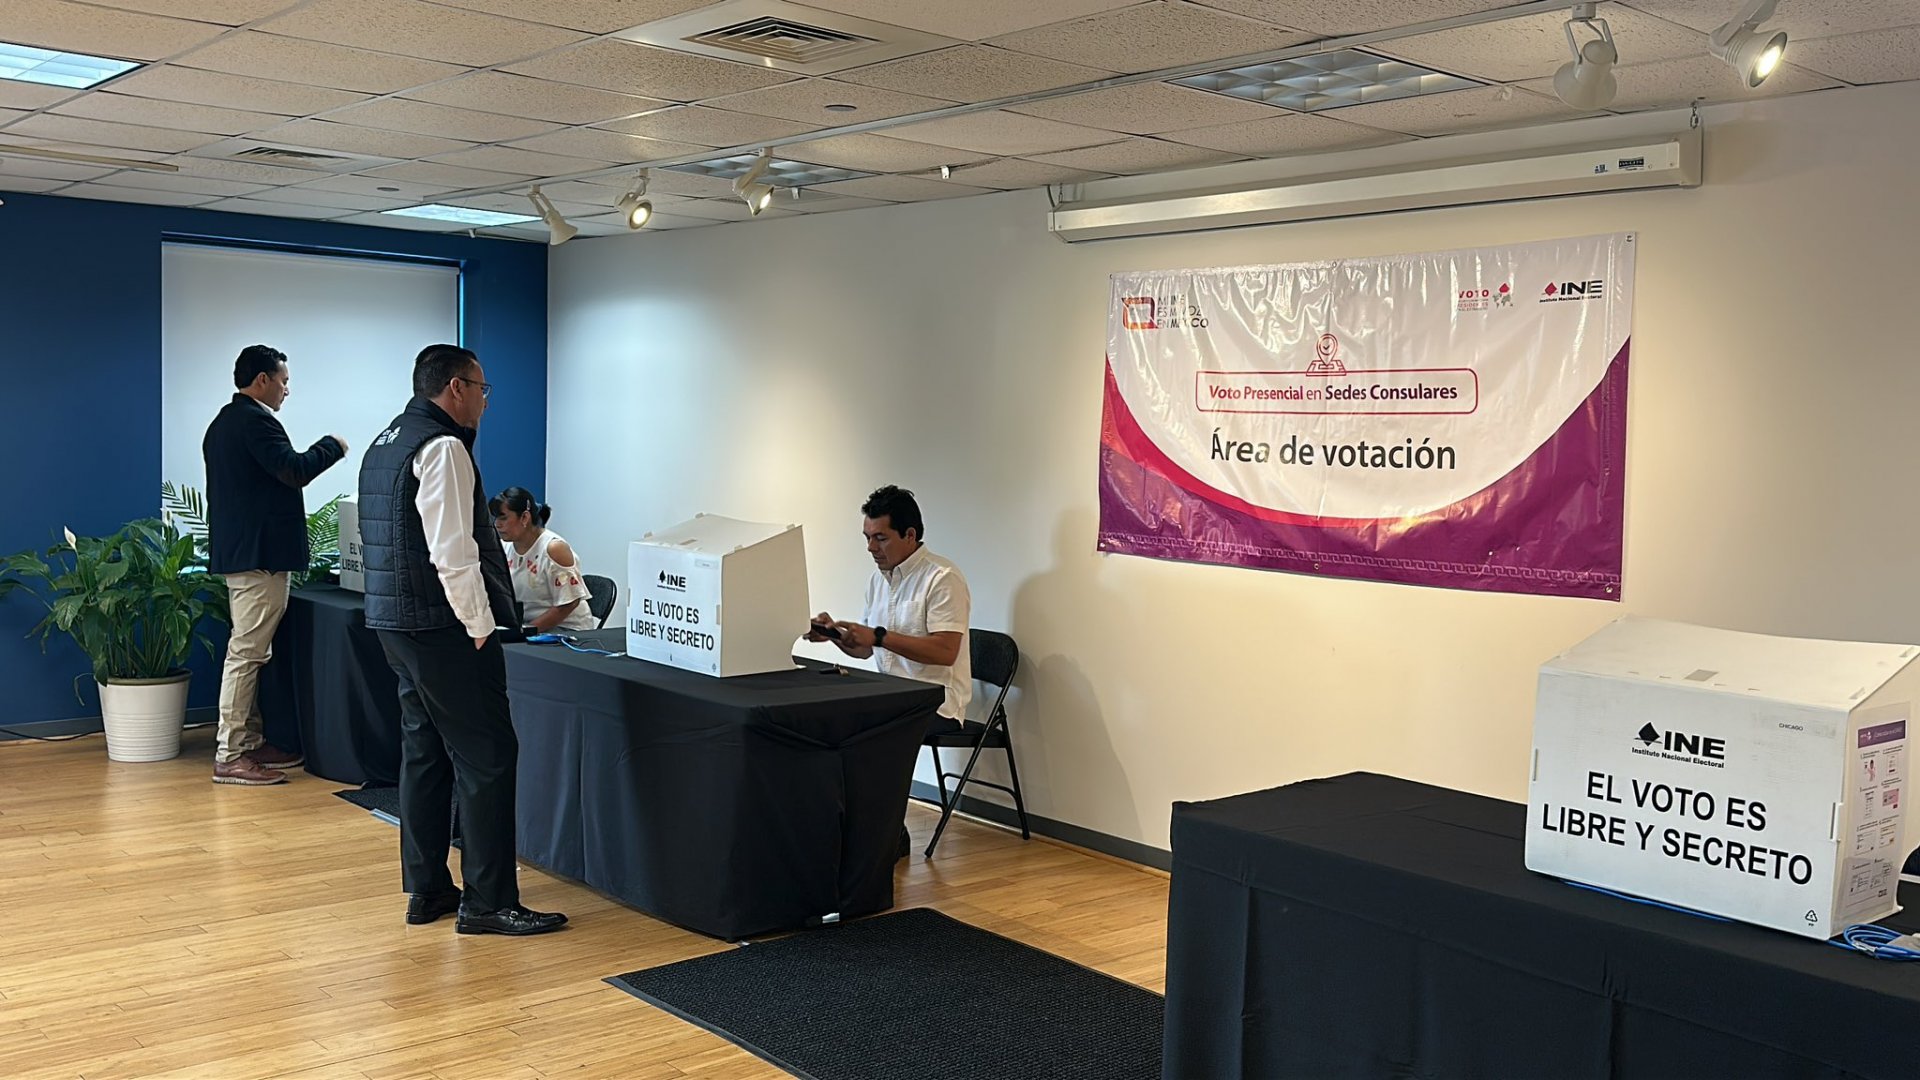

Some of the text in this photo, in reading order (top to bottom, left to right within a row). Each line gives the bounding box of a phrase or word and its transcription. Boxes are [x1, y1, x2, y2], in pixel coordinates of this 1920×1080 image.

[1560, 280, 1603, 295] INE
[1209, 383, 1458, 401] Voto Presencial en Sedes Consulares
[1210, 427, 1456, 470] Área de votación
[342, 558, 359, 573] LIBRE
[668, 574, 687, 588] INE
[644, 599, 699, 625] EL VOTO ES
[630, 618, 715, 651] LIBRE Y SECRETO
[1778, 722, 1804, 732] CHICAGO
[1664, 729, 1726, 760] INE
[1631, 746, 1725, 769] Instituto Nacional Electoral
[1586, 770, 1768, 832] EL VOTO ES
[1542, 803, 1627, 847] LIBRE
[1634, 821, 1655, 851] Y
[1661, 828, 1813, 885] SECRETO
